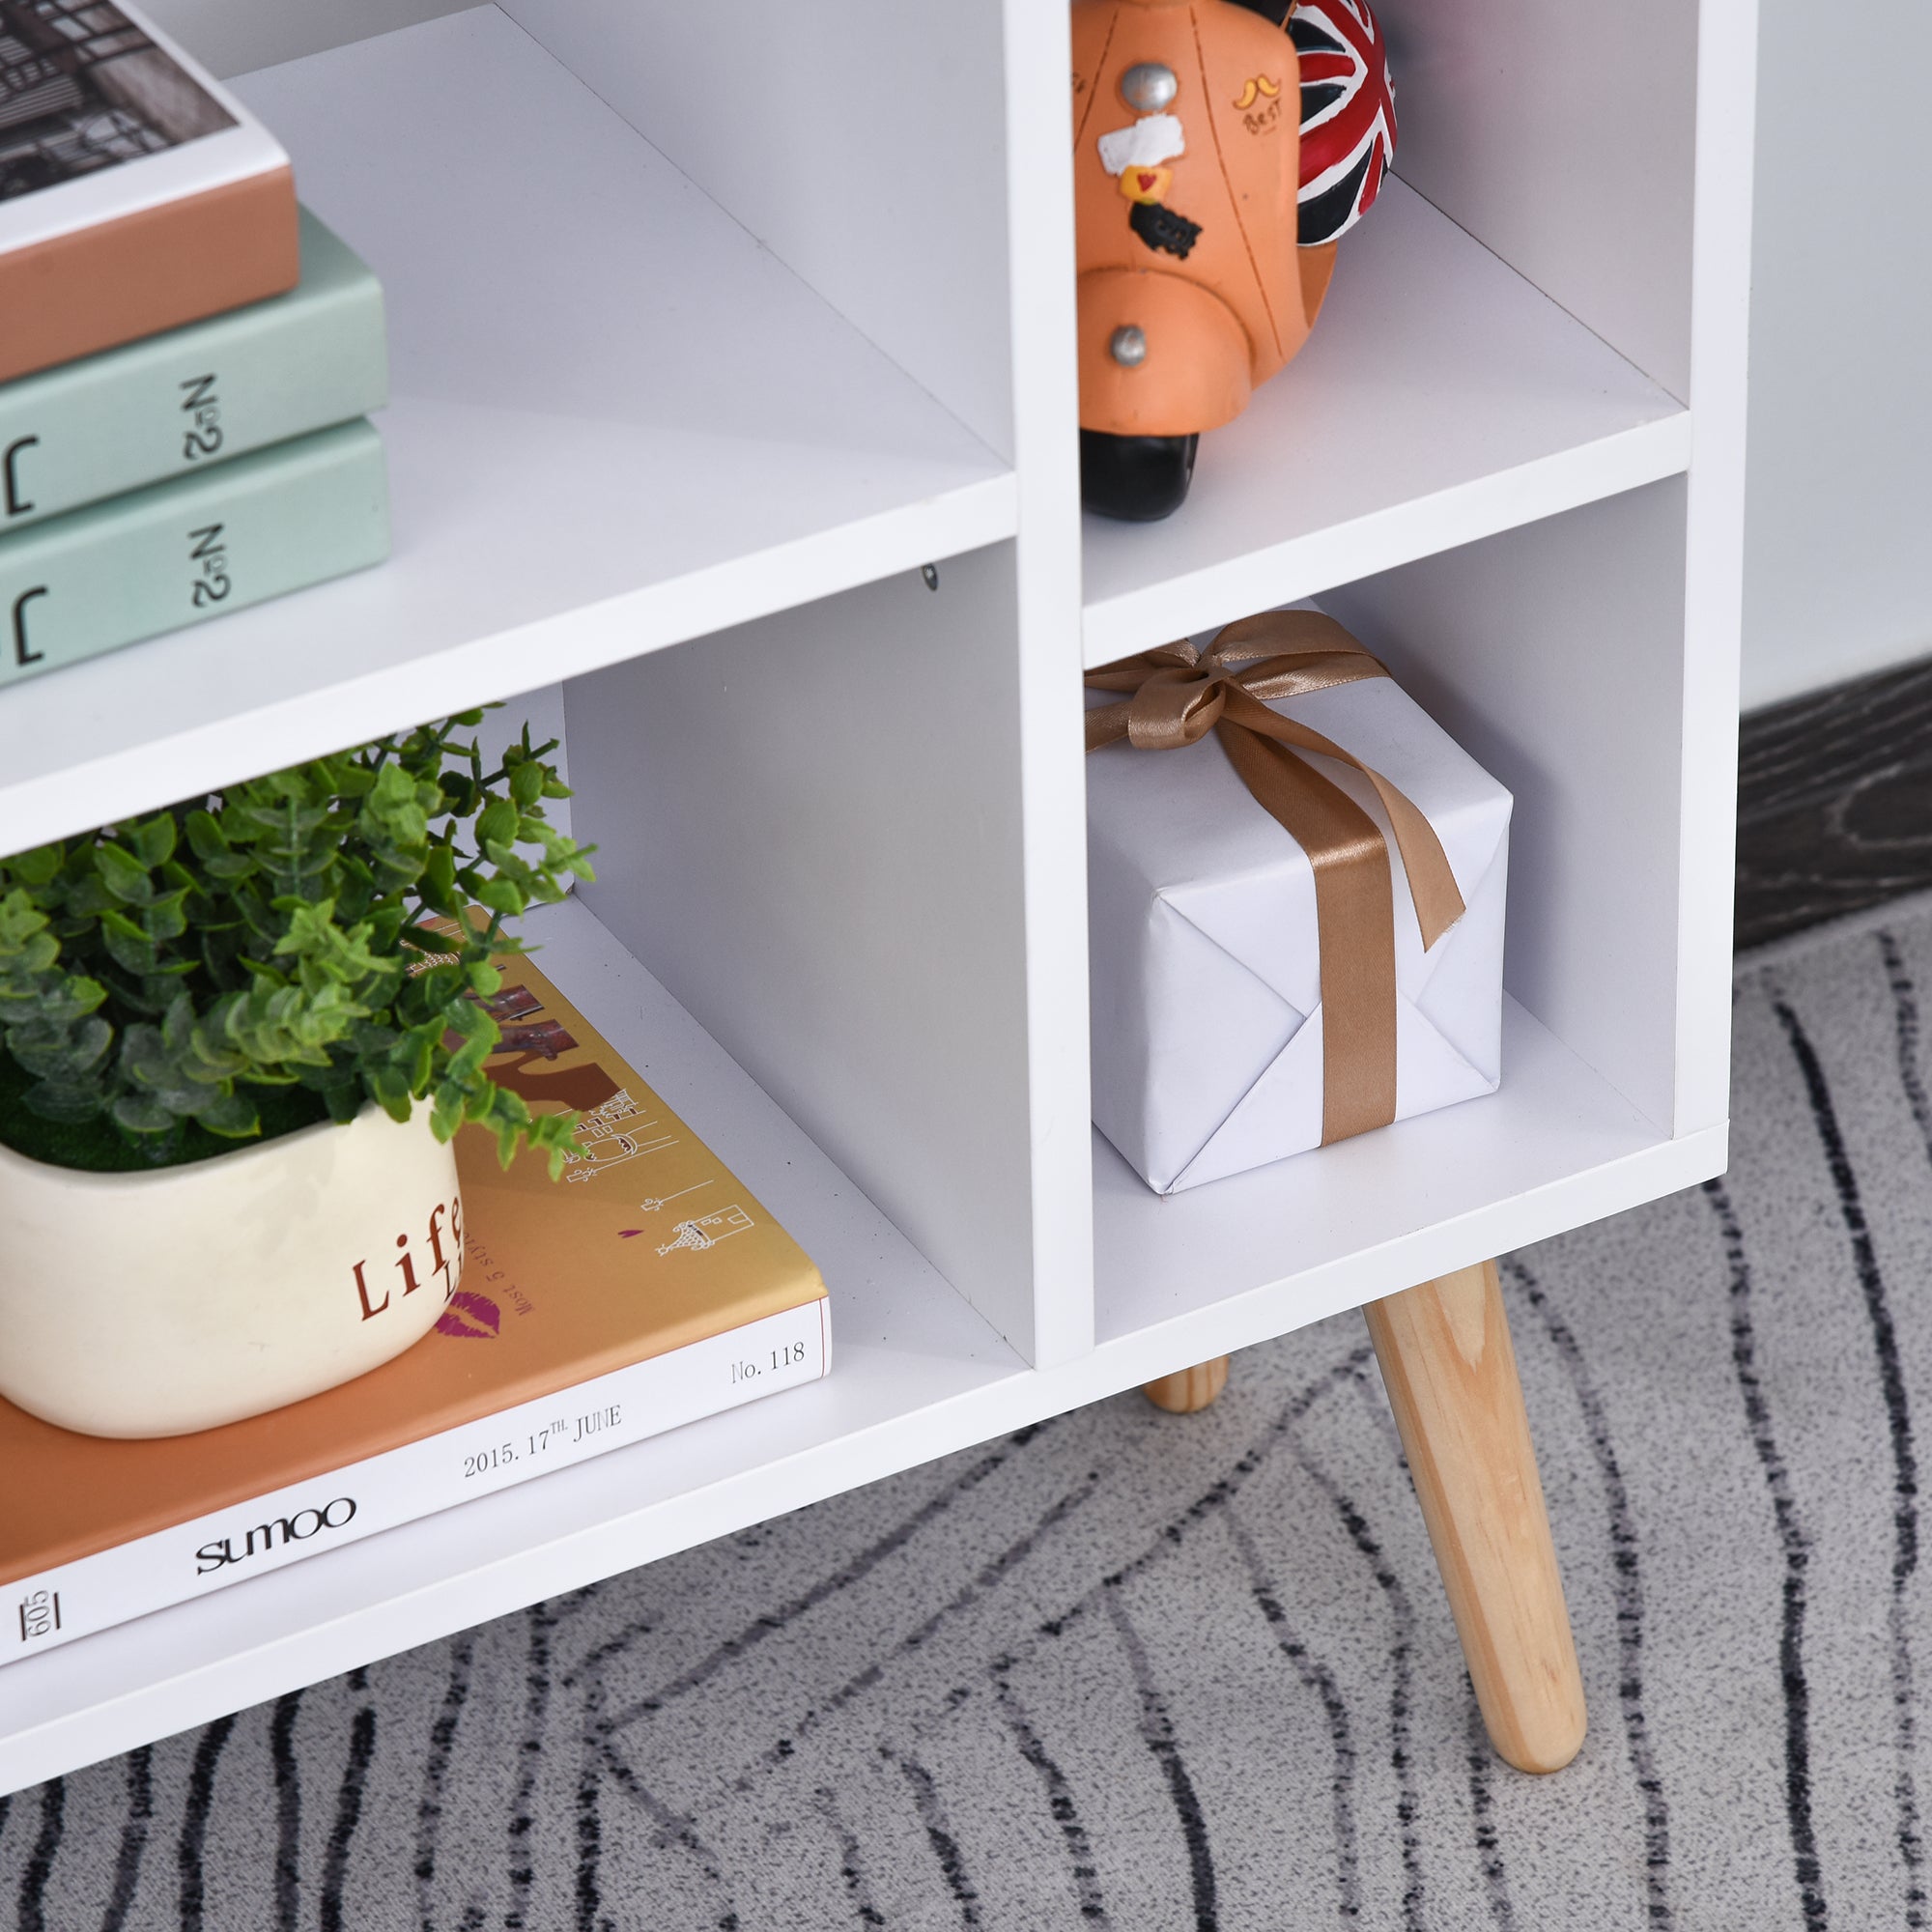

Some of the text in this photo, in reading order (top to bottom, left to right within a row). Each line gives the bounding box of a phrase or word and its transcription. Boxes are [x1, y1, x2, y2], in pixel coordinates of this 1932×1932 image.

[353, 1196, 462, 1321] Life
[731, 1341, 805, 1384] No. 118
[464, 1442, 520, 1478] 2015.
[573, 1404, 622, 1442] JUNE
[196, 1497, 356, 1576] sumoo
